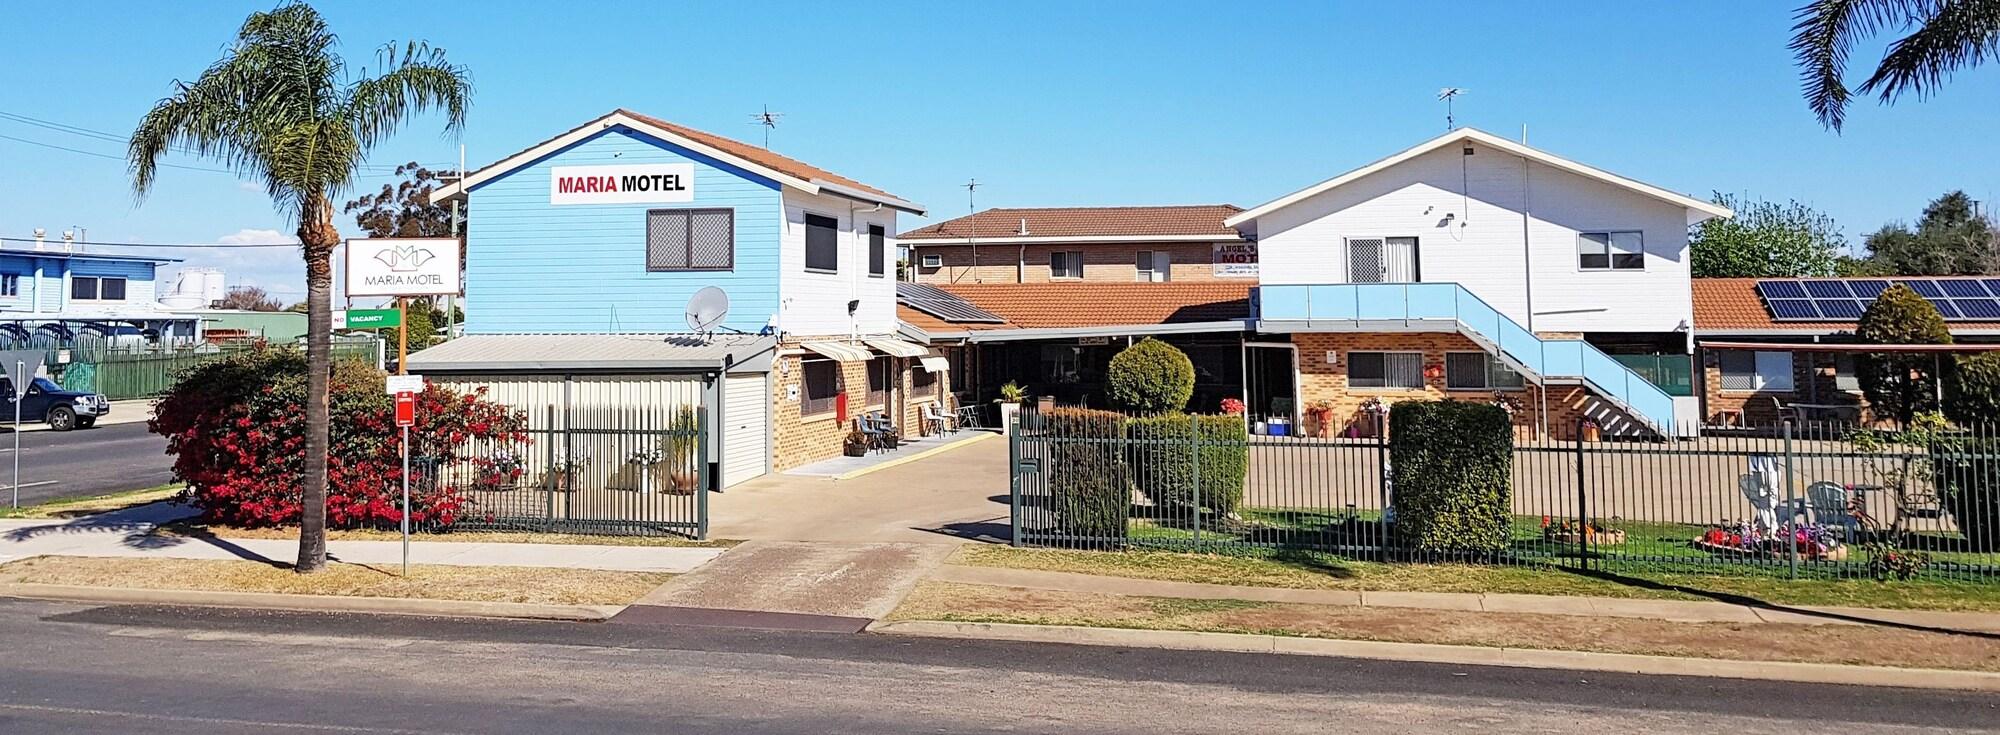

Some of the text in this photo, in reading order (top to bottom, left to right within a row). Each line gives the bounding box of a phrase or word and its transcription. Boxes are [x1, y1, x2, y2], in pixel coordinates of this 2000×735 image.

[559, 175, 685, 193] MARIA MOTEL
[365, 274, 444, 285] MARIA MOTEL
